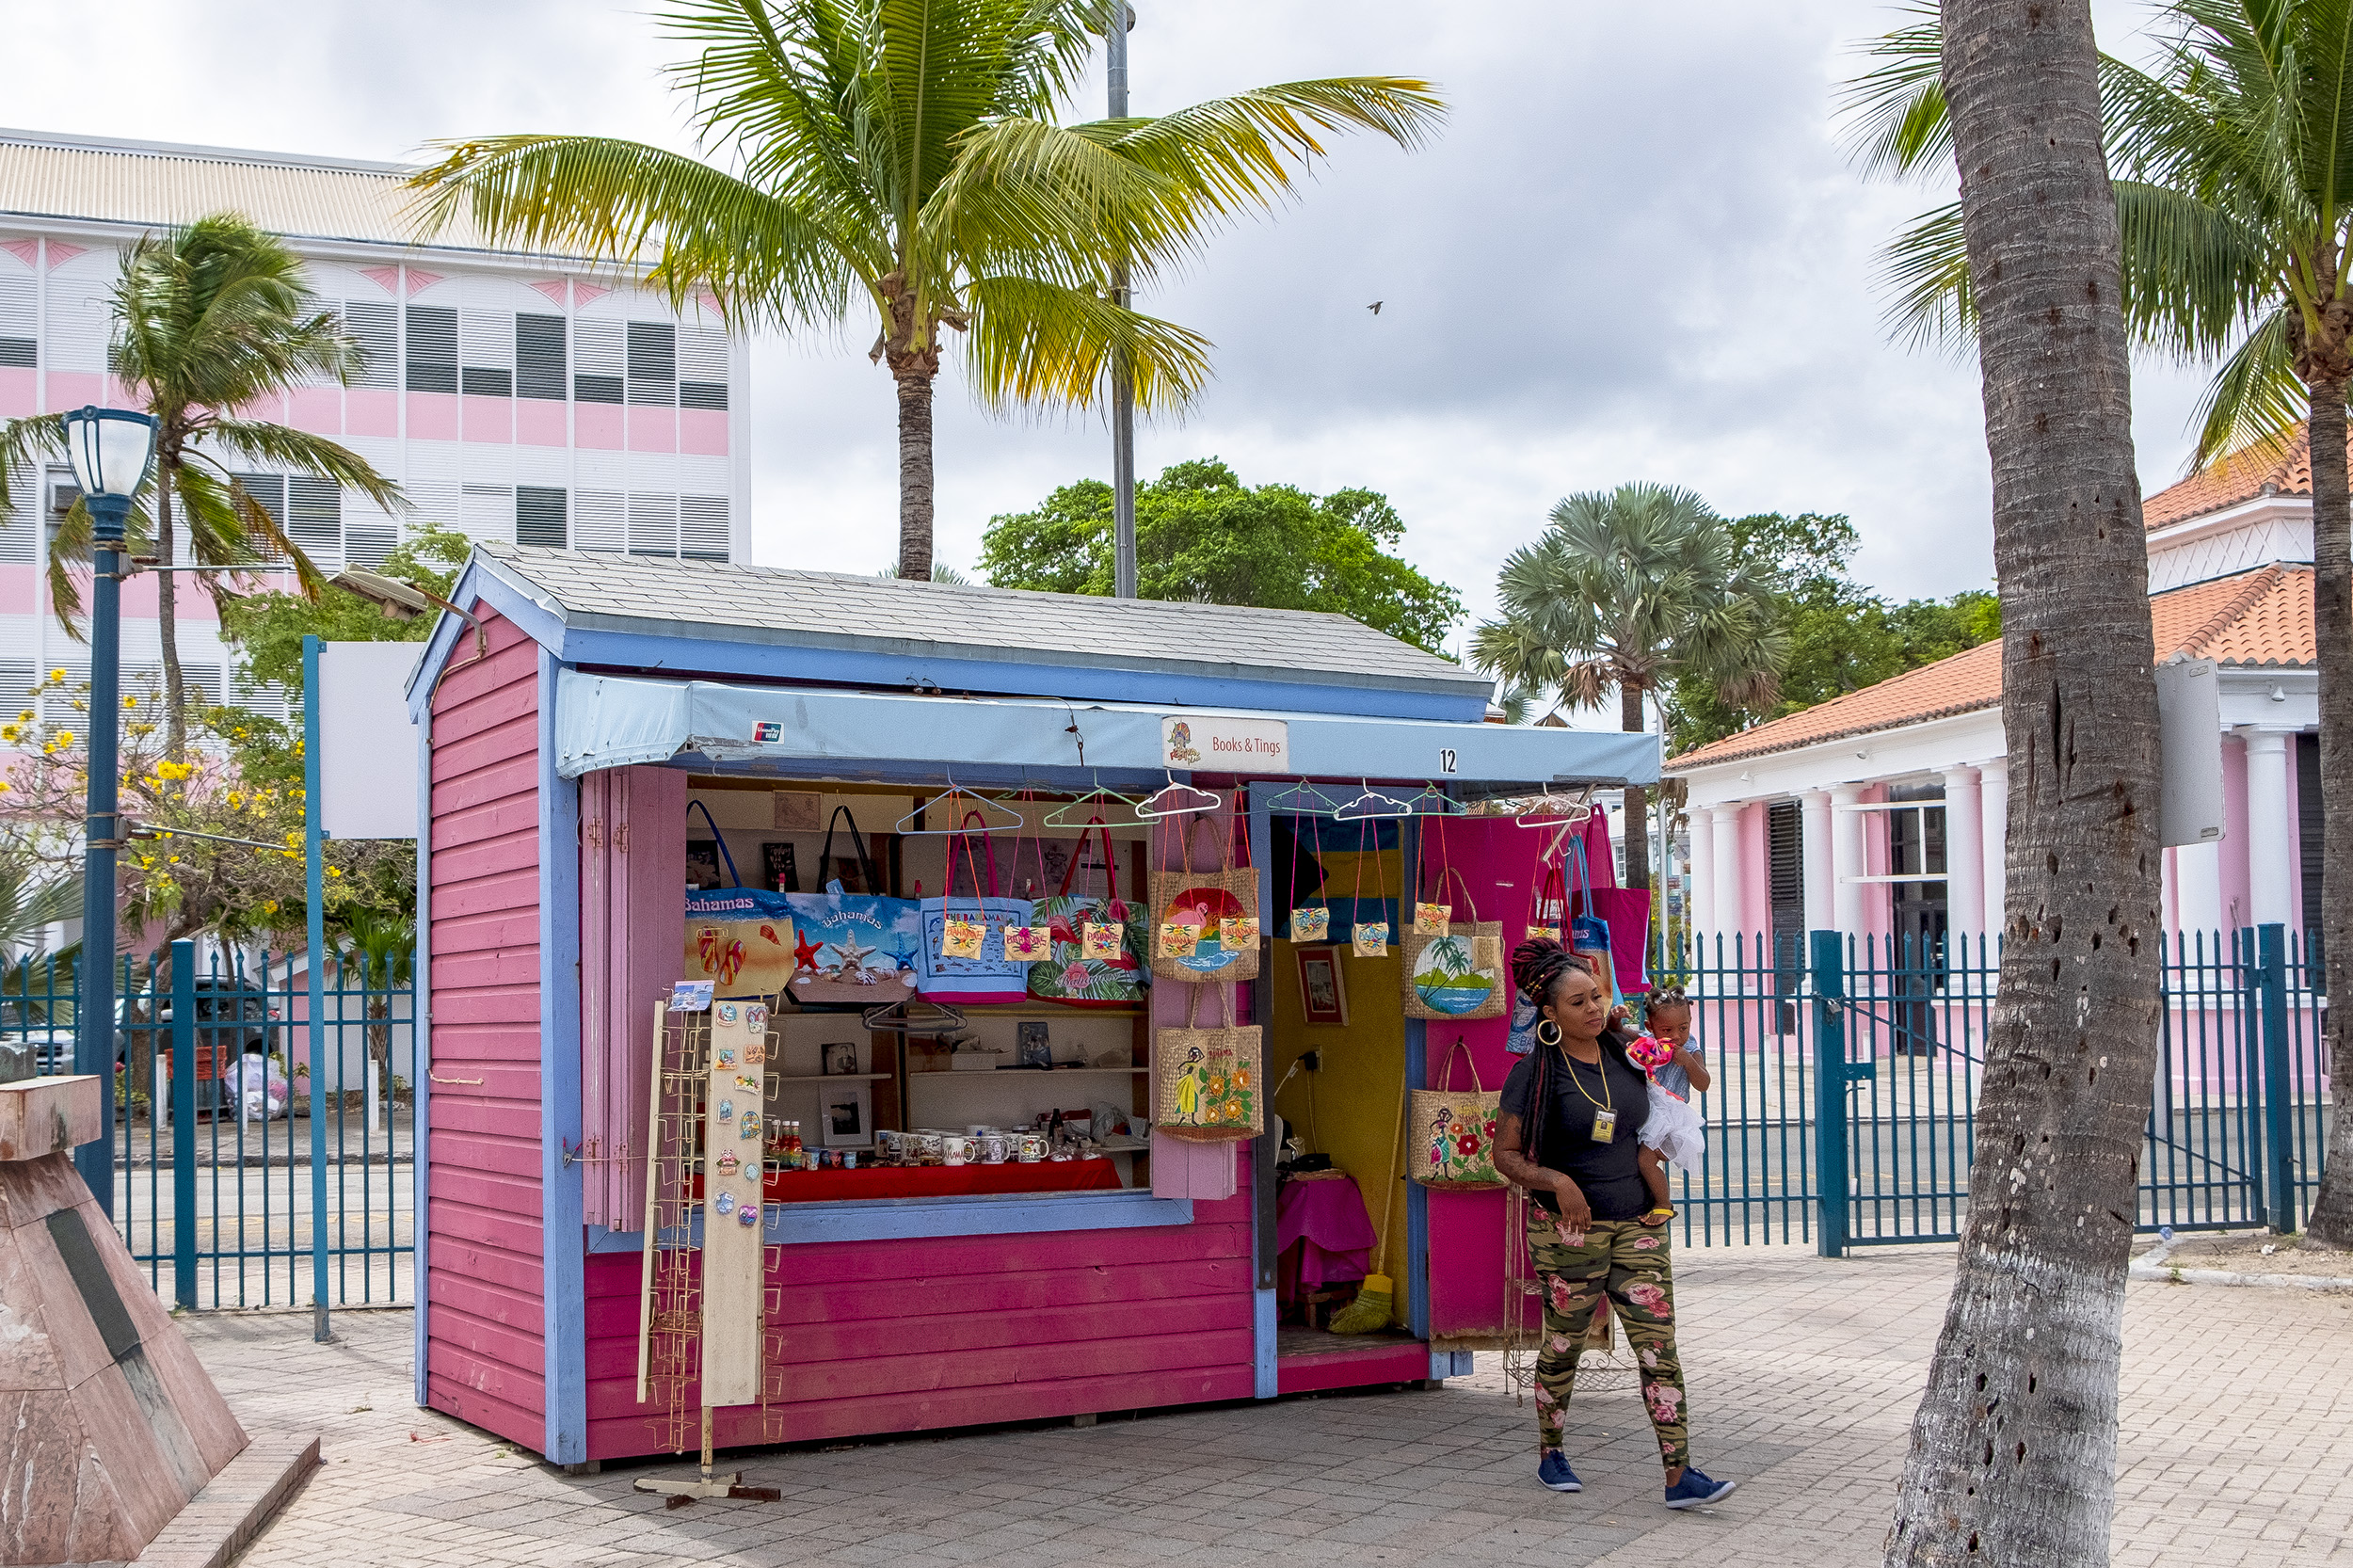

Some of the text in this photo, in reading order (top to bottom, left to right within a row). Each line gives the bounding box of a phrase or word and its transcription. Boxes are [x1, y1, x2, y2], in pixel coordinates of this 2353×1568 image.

[1212, 736, 1280, 757] Books & Tings
[1440, 749, 1456, 773] 12
[822, 911, 883, 930] Bahamas
[946, 913, 1006, 922] THE BAHAMAS
